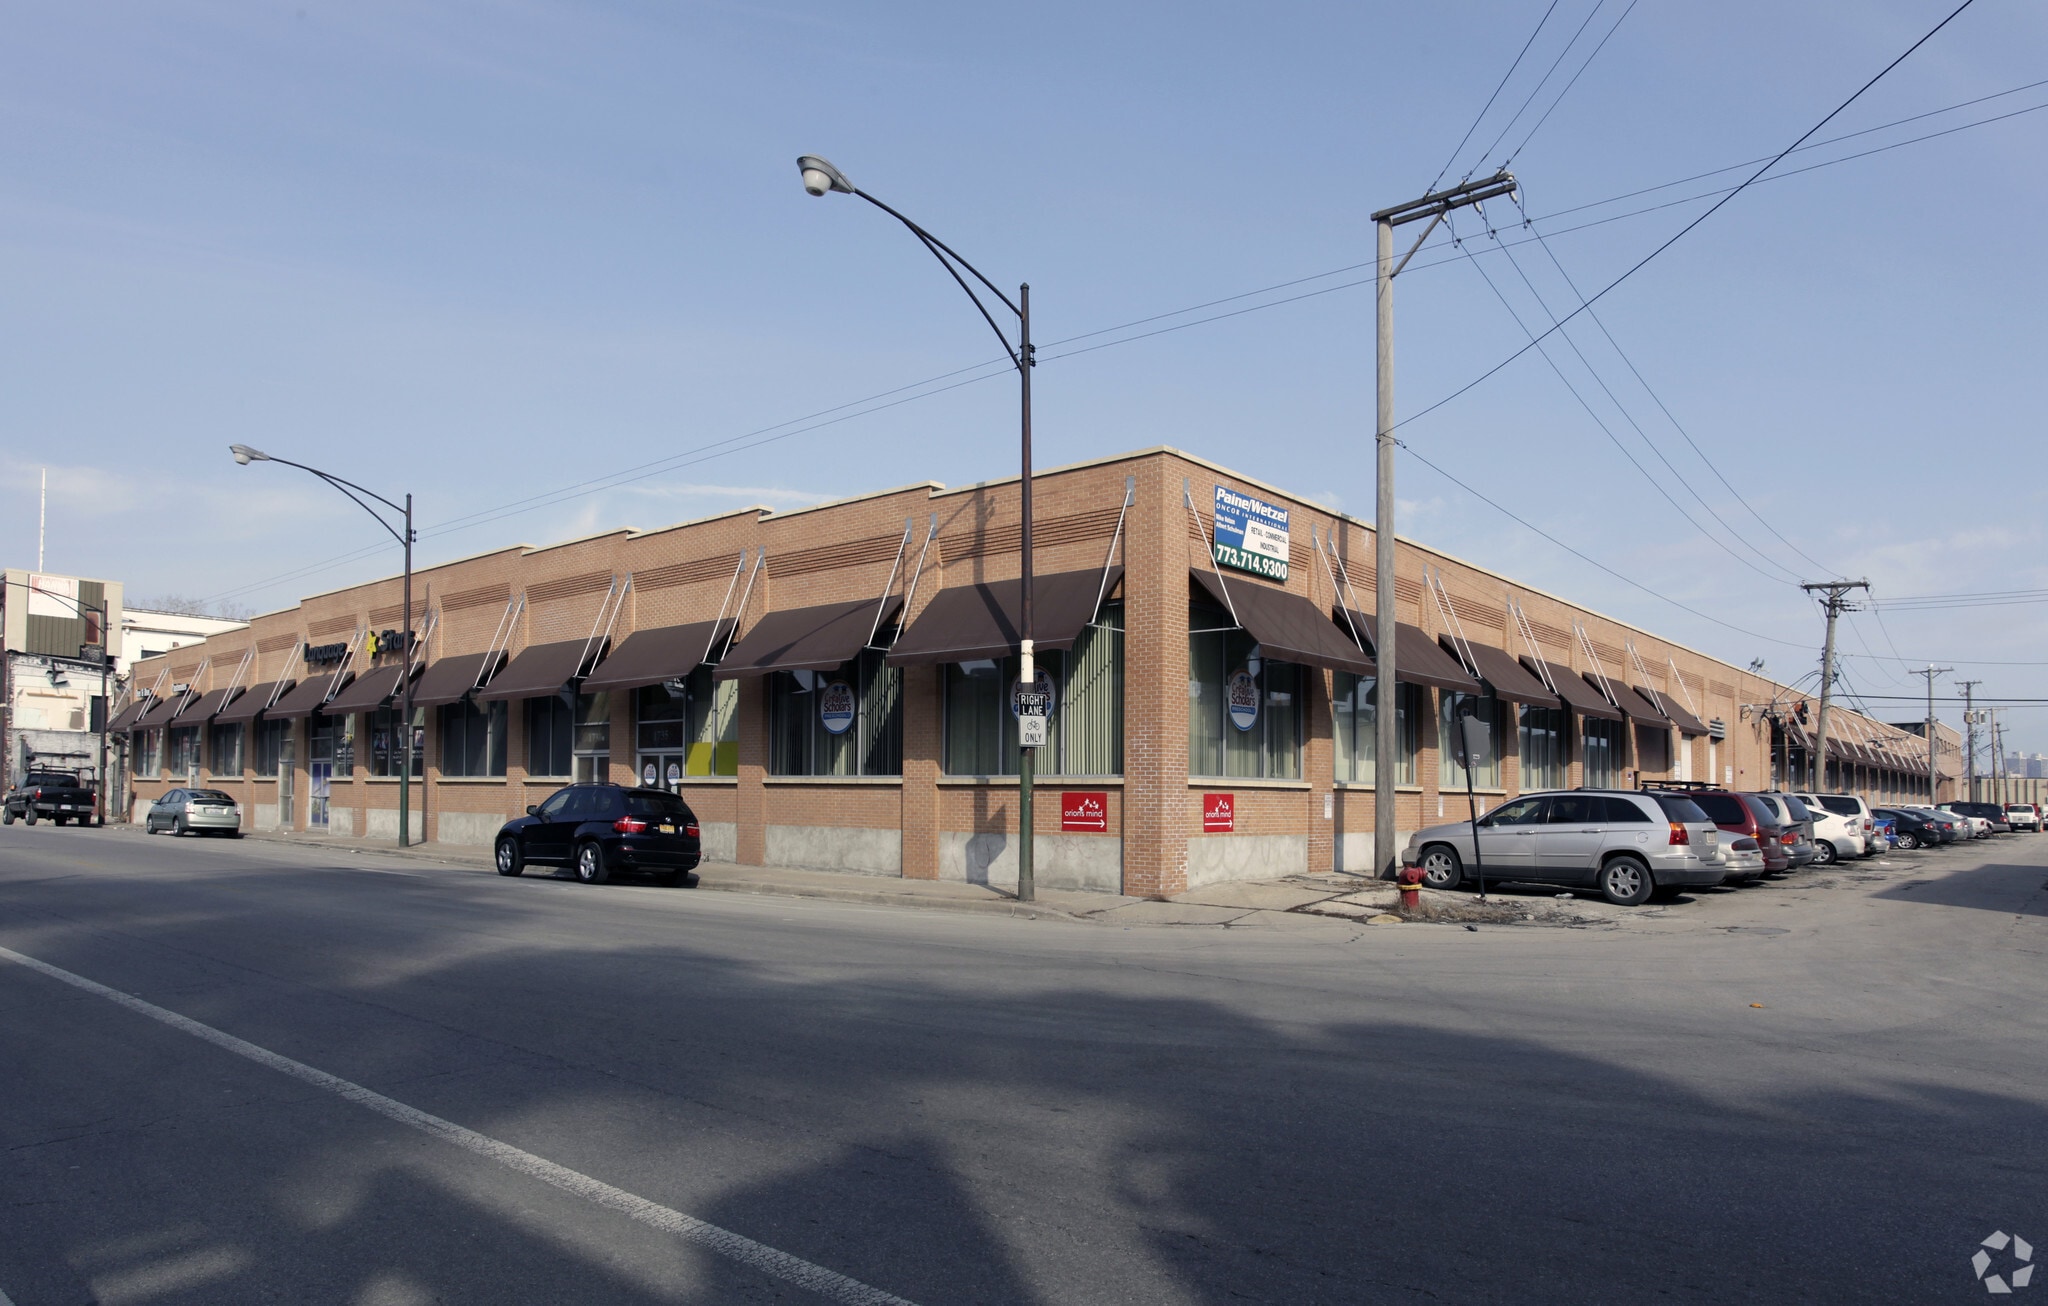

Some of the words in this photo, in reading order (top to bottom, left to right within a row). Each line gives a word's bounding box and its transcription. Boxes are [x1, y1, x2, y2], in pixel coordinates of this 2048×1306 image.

[1216, 502, 1240, 516] ONCOR
[1217, 544, 1287, 579] 773.714.9300
[304, 642, 347, 665] Language
[1020, 694, 1044, 706] RIGHT
[1231, 692, 1256, 707] Scholars
[823, 702, 852, 713] Scholars
[1022, 705, 1043, 716] LANE
[1024, 733, 1042, 743] ONLY
[1086, 809, 1103, 817] mind
[1220, 810, 1231, 818] mind
